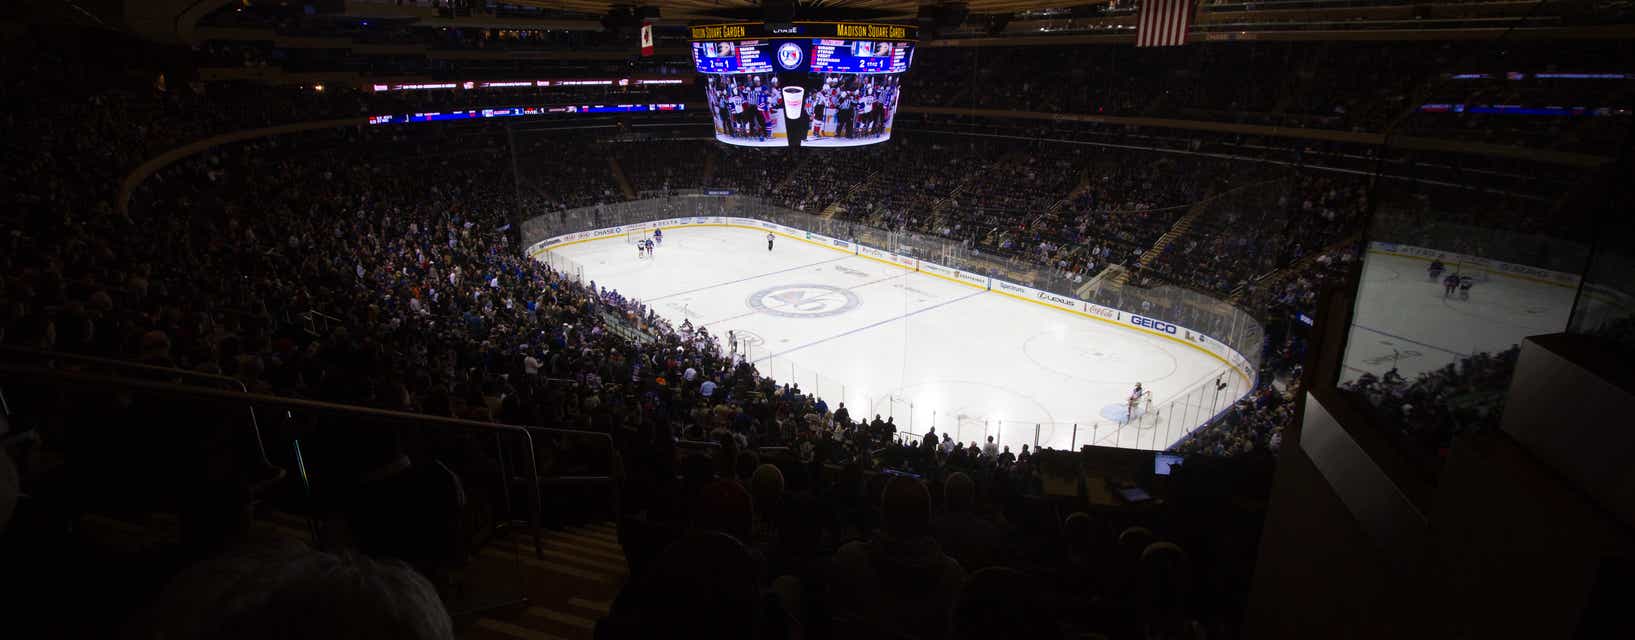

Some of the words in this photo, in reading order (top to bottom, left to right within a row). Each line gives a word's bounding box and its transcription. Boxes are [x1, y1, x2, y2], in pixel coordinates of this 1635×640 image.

[723, 25, 745, 37] GARDEN
[837, 23, 867, 37] MADISON
[868, 24, 888, 37] SQUARE
[889, 25, 906, 38] GARDEN
[1131, 315, 1177, 335] GEICO
